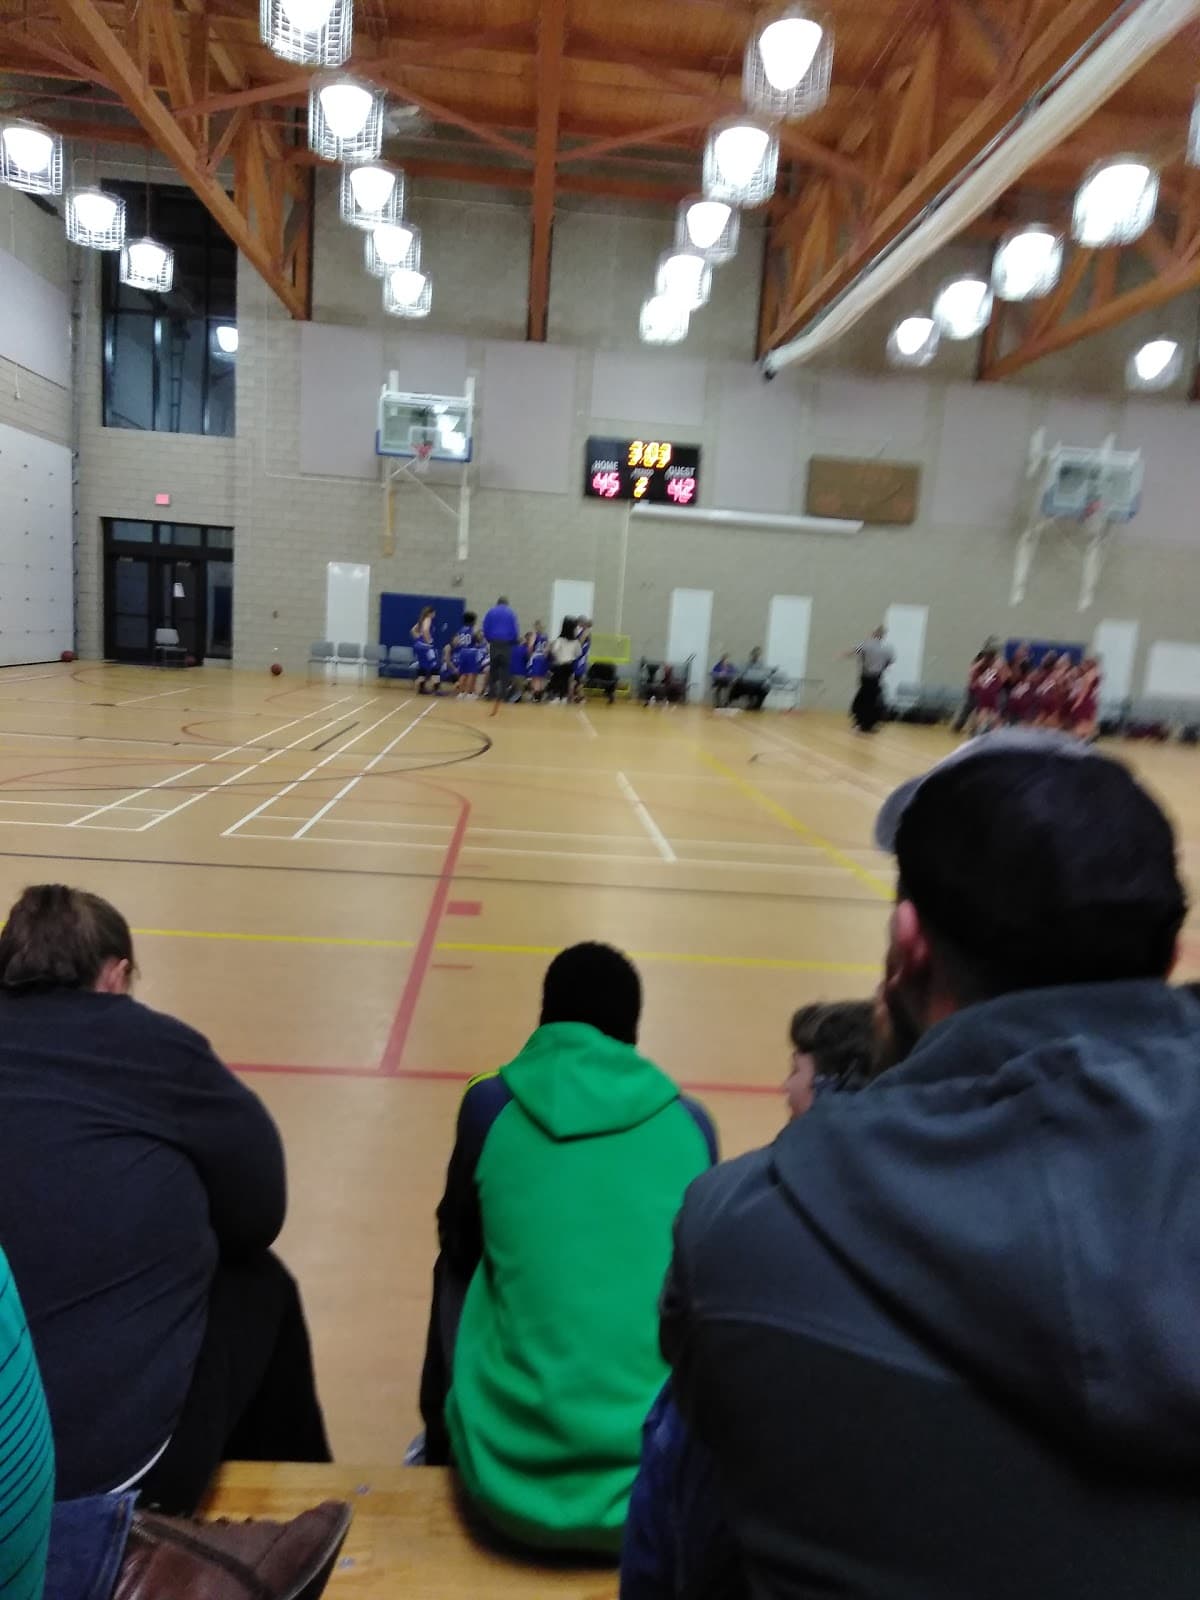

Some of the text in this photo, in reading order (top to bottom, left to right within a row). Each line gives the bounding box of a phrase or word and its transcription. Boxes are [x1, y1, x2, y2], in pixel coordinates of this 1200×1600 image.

[591, 460, 618, 473] HOME
[665, 467, 695, 480] GUEST
[592, 472, 620, 497] 45
[667, 478, 696, 503] 42
